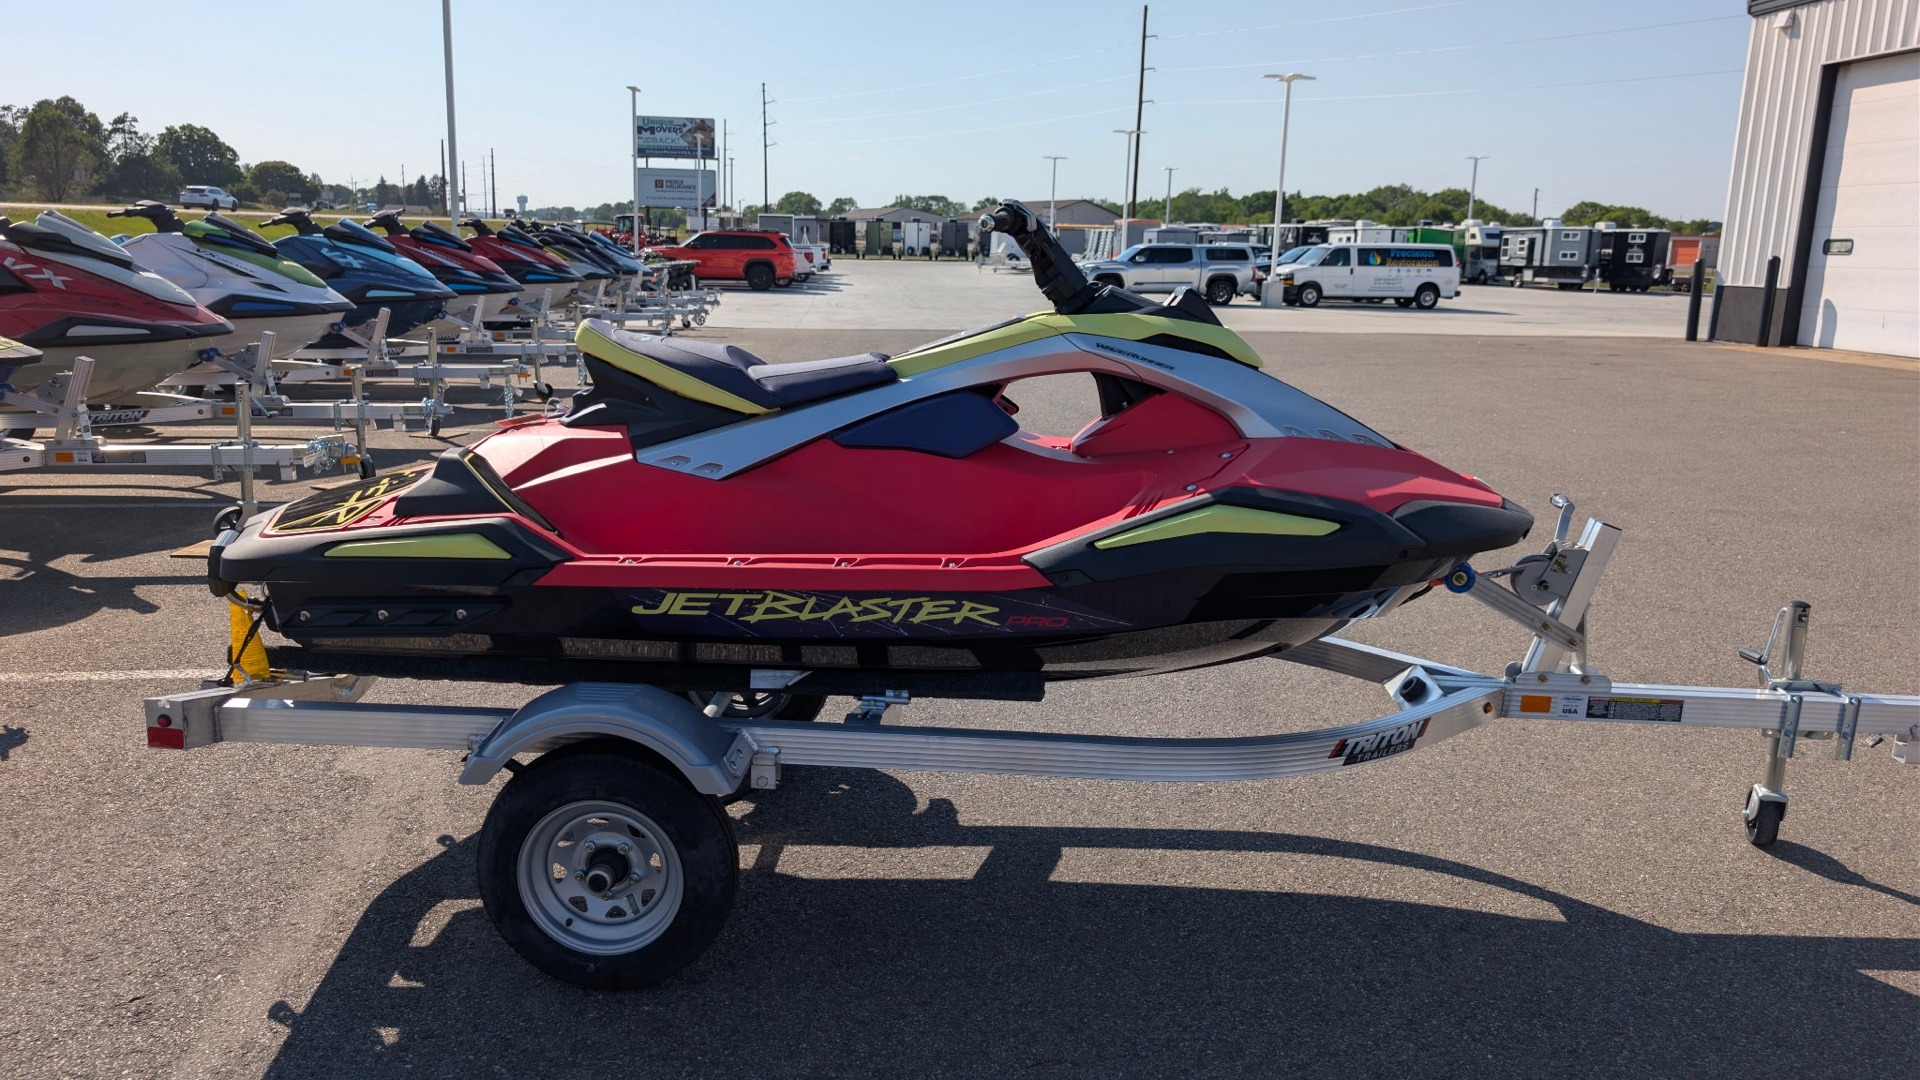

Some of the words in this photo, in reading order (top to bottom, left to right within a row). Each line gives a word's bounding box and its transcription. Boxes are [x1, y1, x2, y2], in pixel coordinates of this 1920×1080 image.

[643, 118, 674, 126] UNIQUE
[637, 125, 684, 136] MOVERS
[1390, 249, 1435, 258] Precision
[1386, 258, 1439, 267] Restoration
[89, 411, 143, 423] TRITON
[1005, 615, 1069, 628] PRO
[1342, 720, 1424, 757] TRITON
[1357, 742, 1409, 763] TRAILERS
